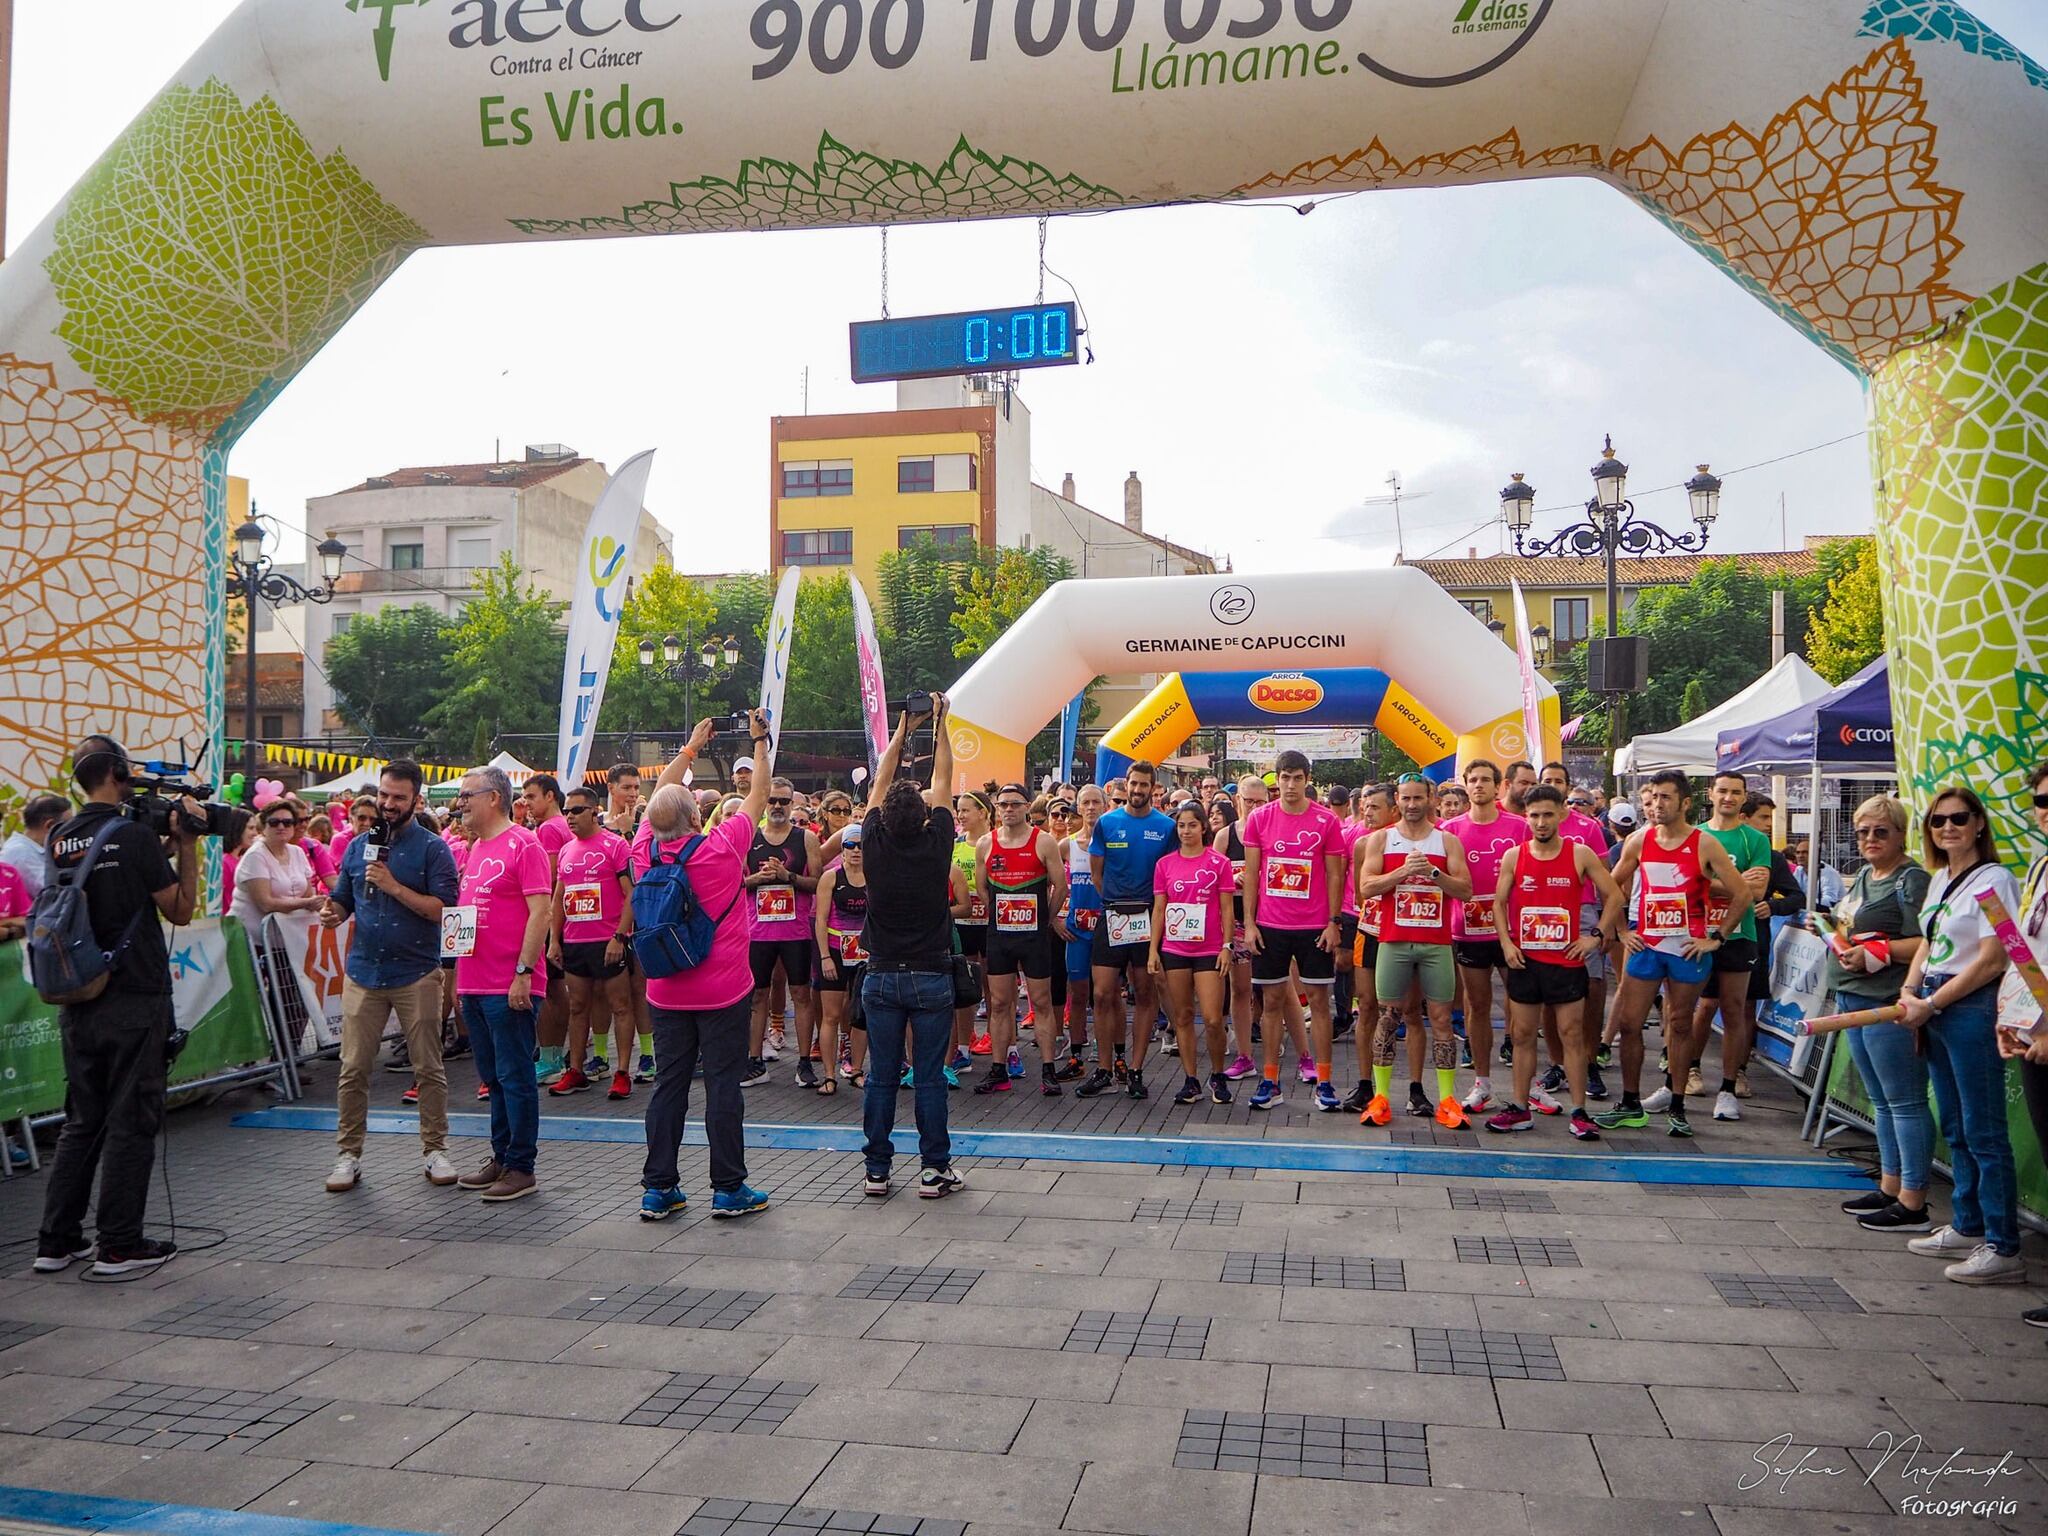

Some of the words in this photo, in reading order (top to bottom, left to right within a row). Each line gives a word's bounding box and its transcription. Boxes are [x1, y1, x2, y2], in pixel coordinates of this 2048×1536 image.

[449, 0, 682, 49] aecc
[1452, 25, 1460, 34] a
[1462, 22, 1474, 33] la
[1477, 20, 1527, 32] semana
[749, 0, 925, 80] 900
[963, 0, 1136, 61] 100
[490, 55, 552, 76] Contra
[559, 55, 573, 71] el
[579, 47, 643, 69] Cáncer
[1112, 40, 1349, 93] Llámame.
[480, 96, 533, 147] Es
[544, 84, 684, 142] Vida.
[966, 311, 1066, 363] 0:00
[1126, 637, 1223, 653] GERMAINE
[1225, 637, 1239, 646] DE
[1241, 634, 1346, 650] CAPUCCINI
[1257, 684, 1317, 702] Dacsa
[1130, 724, 1157, 750] ARROZ
[1154, 701, 1182, 726] DACSA
[1391, 700, 1421, 726] ARROZ
[1418, 722, 1446, 750] DACSA
[1259, 738, 1276, 748] 23
[1282, 873, 1302, 887] 497
[575, 898, 595, 912] 1152
[770, 900, 787, 911] 491
[1410, 902, 1437, 917] 1032
[1008, 909, 1032, 922] 1308
[1655, 911, 1682, 925] 1026
[1129, 920, 1146, 930] 1921
[1185, 919, 1199, 929] 152
[1535, 924, 1564, 939] 1040
[458, 926, 475, 940] 2270
[4, 1017, 51, 1036] mueves
